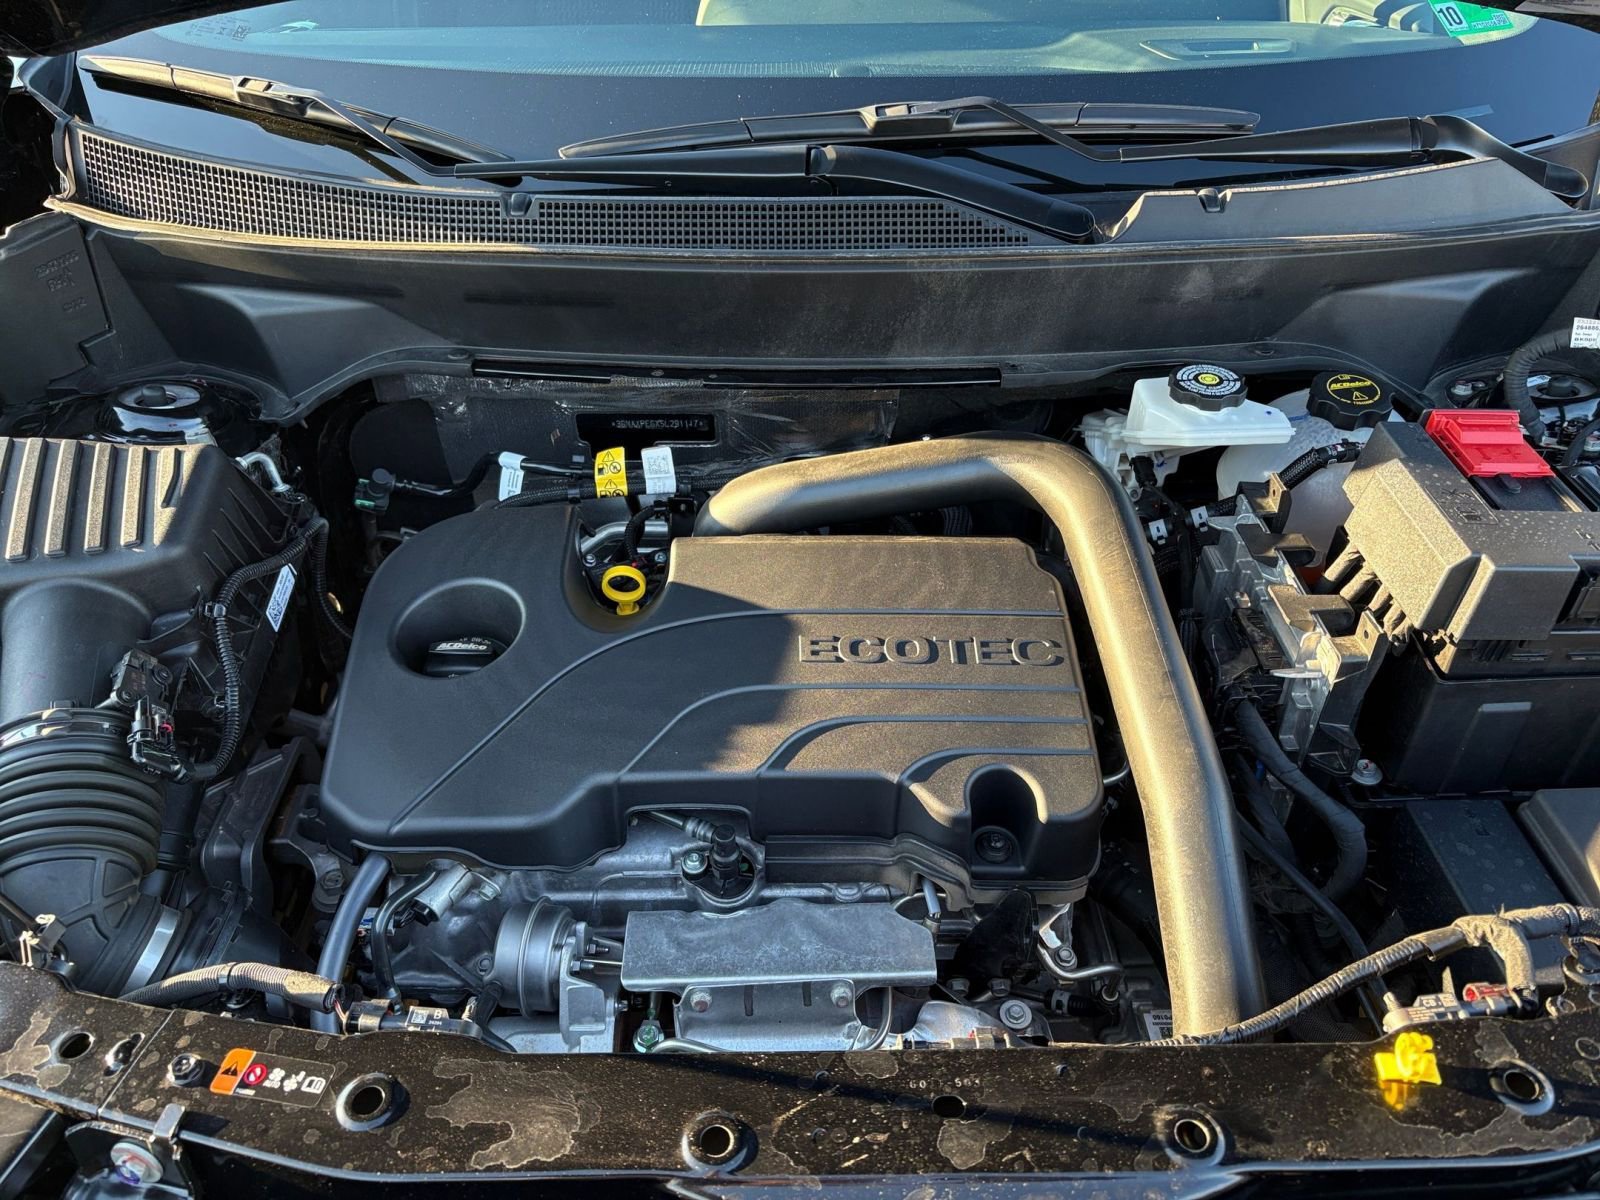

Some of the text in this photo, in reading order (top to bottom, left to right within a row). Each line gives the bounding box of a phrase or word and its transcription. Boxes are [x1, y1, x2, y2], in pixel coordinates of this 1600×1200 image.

[1437, 6, 1464, 27] 10
[435, 642, 488, 651] ACDelco
[798, 635, 1066, 666] ECOTEC
[433, 1009, 443, 1020] B
